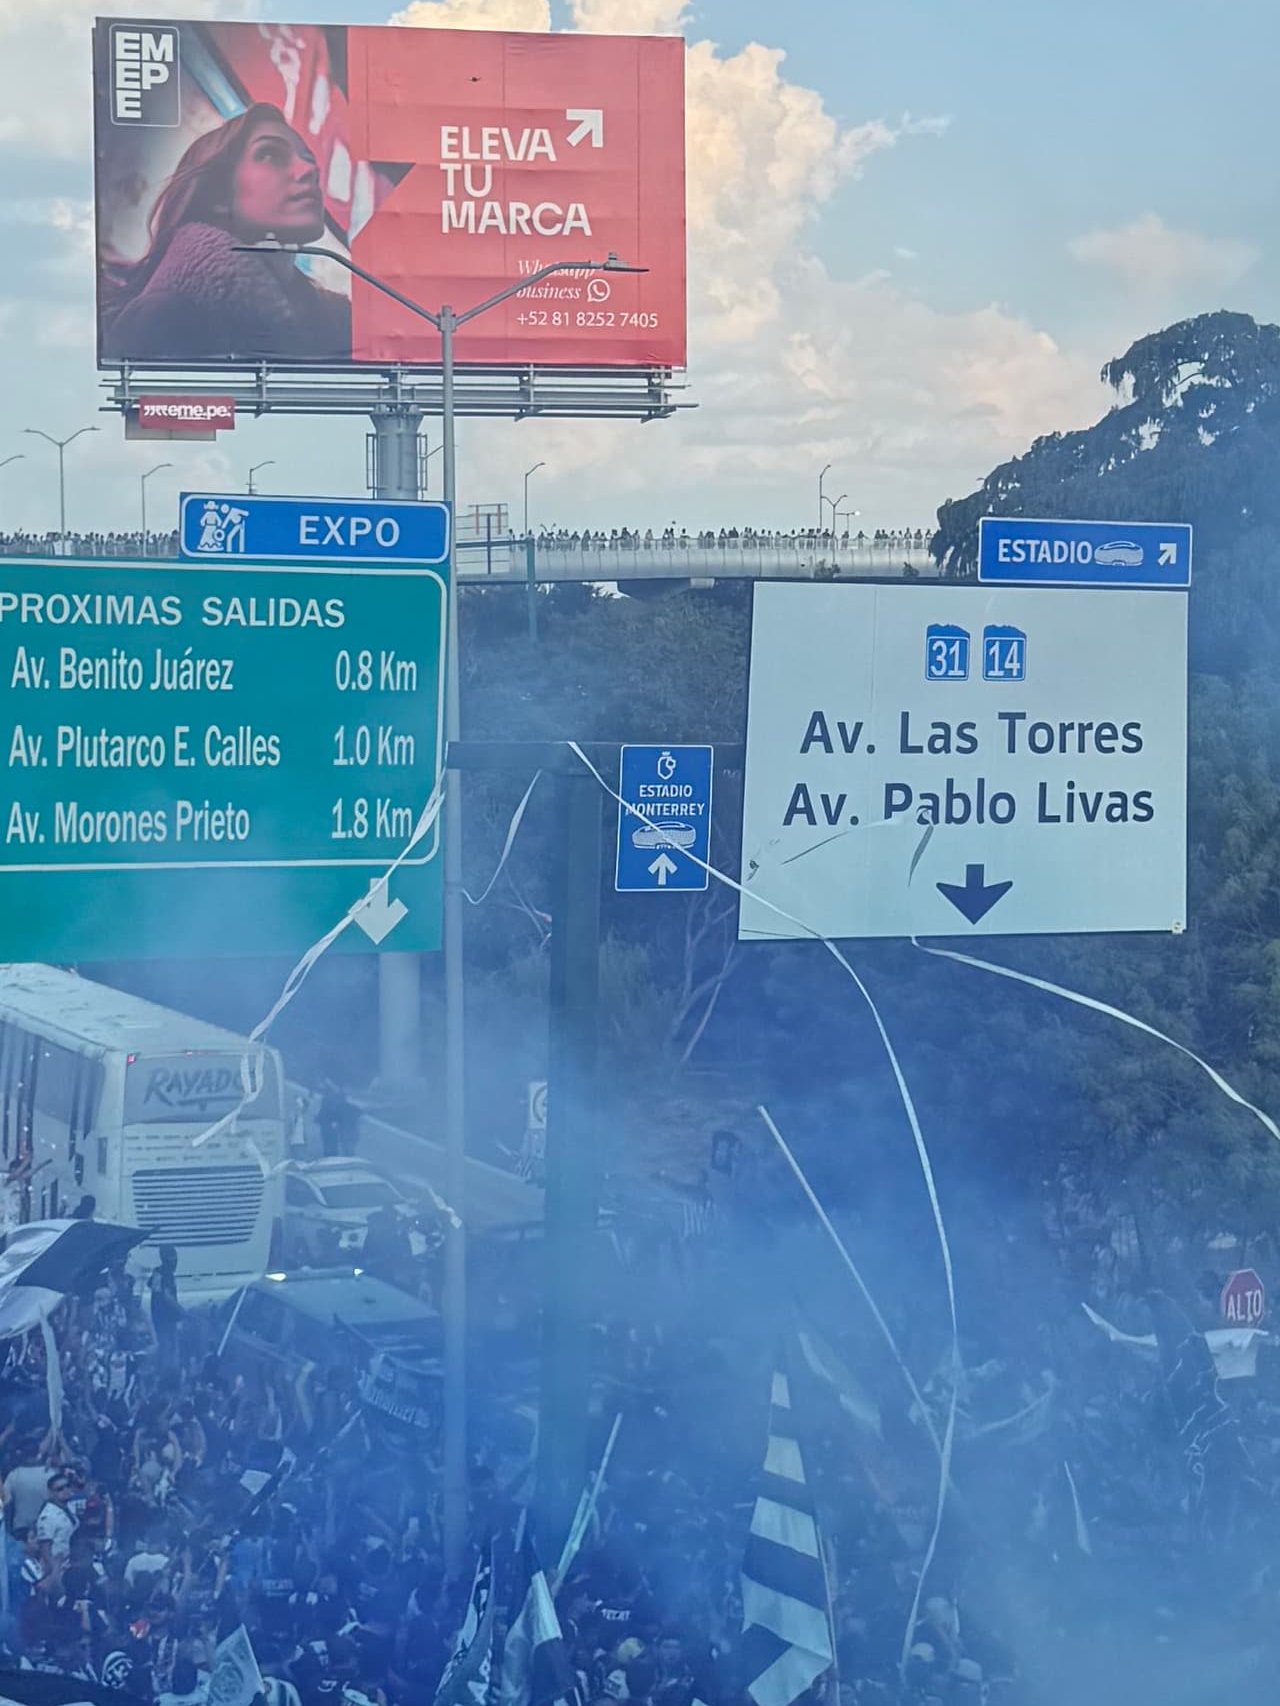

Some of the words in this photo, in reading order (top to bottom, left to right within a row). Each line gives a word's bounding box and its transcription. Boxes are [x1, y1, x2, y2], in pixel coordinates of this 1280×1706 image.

[115, 31, 174, 63] EM
[115, 62, 169, 90] EP
[115, 91, 142, 118] E
[440, 126, 557, 162] ELEVA
[440, 163, 492, 198] TU
[440, 200, 592, 236] MARCA
[517, 311, 548, 326] +52
[552, 311, 570, 326] 81
[576, 312, 615, 326] 8252
[620, 313, 658, 328] 7405
[298, 515, 400, 548] EXPO
[997, 539, 1093, 564] ESTADIO
[202, 597, 345, 629] SALIDAS
[11, 646, 50, 690] Av.
[59, 648, 143, 690] Benito
[149, 646, 234, 691] Juárez
[335, 650, 372, 690] 0.8
[379, 651, 417, 691] Km
[931, 641, 966, 677] 31
[988, 643, 1021, 678] 14
[8, 725, 48, 767] Av.
[56, 725, 166, 768] Plutarco
[174, 725, 196, 767] E.
[204, 725, 281, 767] Calles
[333, 726, 371, 765] 1.0
[378, 726, 415, 765] Km
[800, 711, 877, 754] Av.
[899, 711, 979, 755] Las
[998, 712, 1144, 754] Torres
[639, 784, 693, 797] ESTADIO
[782, 783, 859, 826] Av.
[884, 778, 1017, 825] Pablo
[1038, 780, 1155, 824] Livas
[6, 802, 45, 844] Av.
[54, 802, 167, 843] Morones
[176, 801, 250, 841] Prieto
[331, 798, 368, 839] 1.8
[376, 798, 412, 838] Km
[625, 803, 705, 816] MONTERREY
[1227, 1289, 1262, 1322] ALTO
